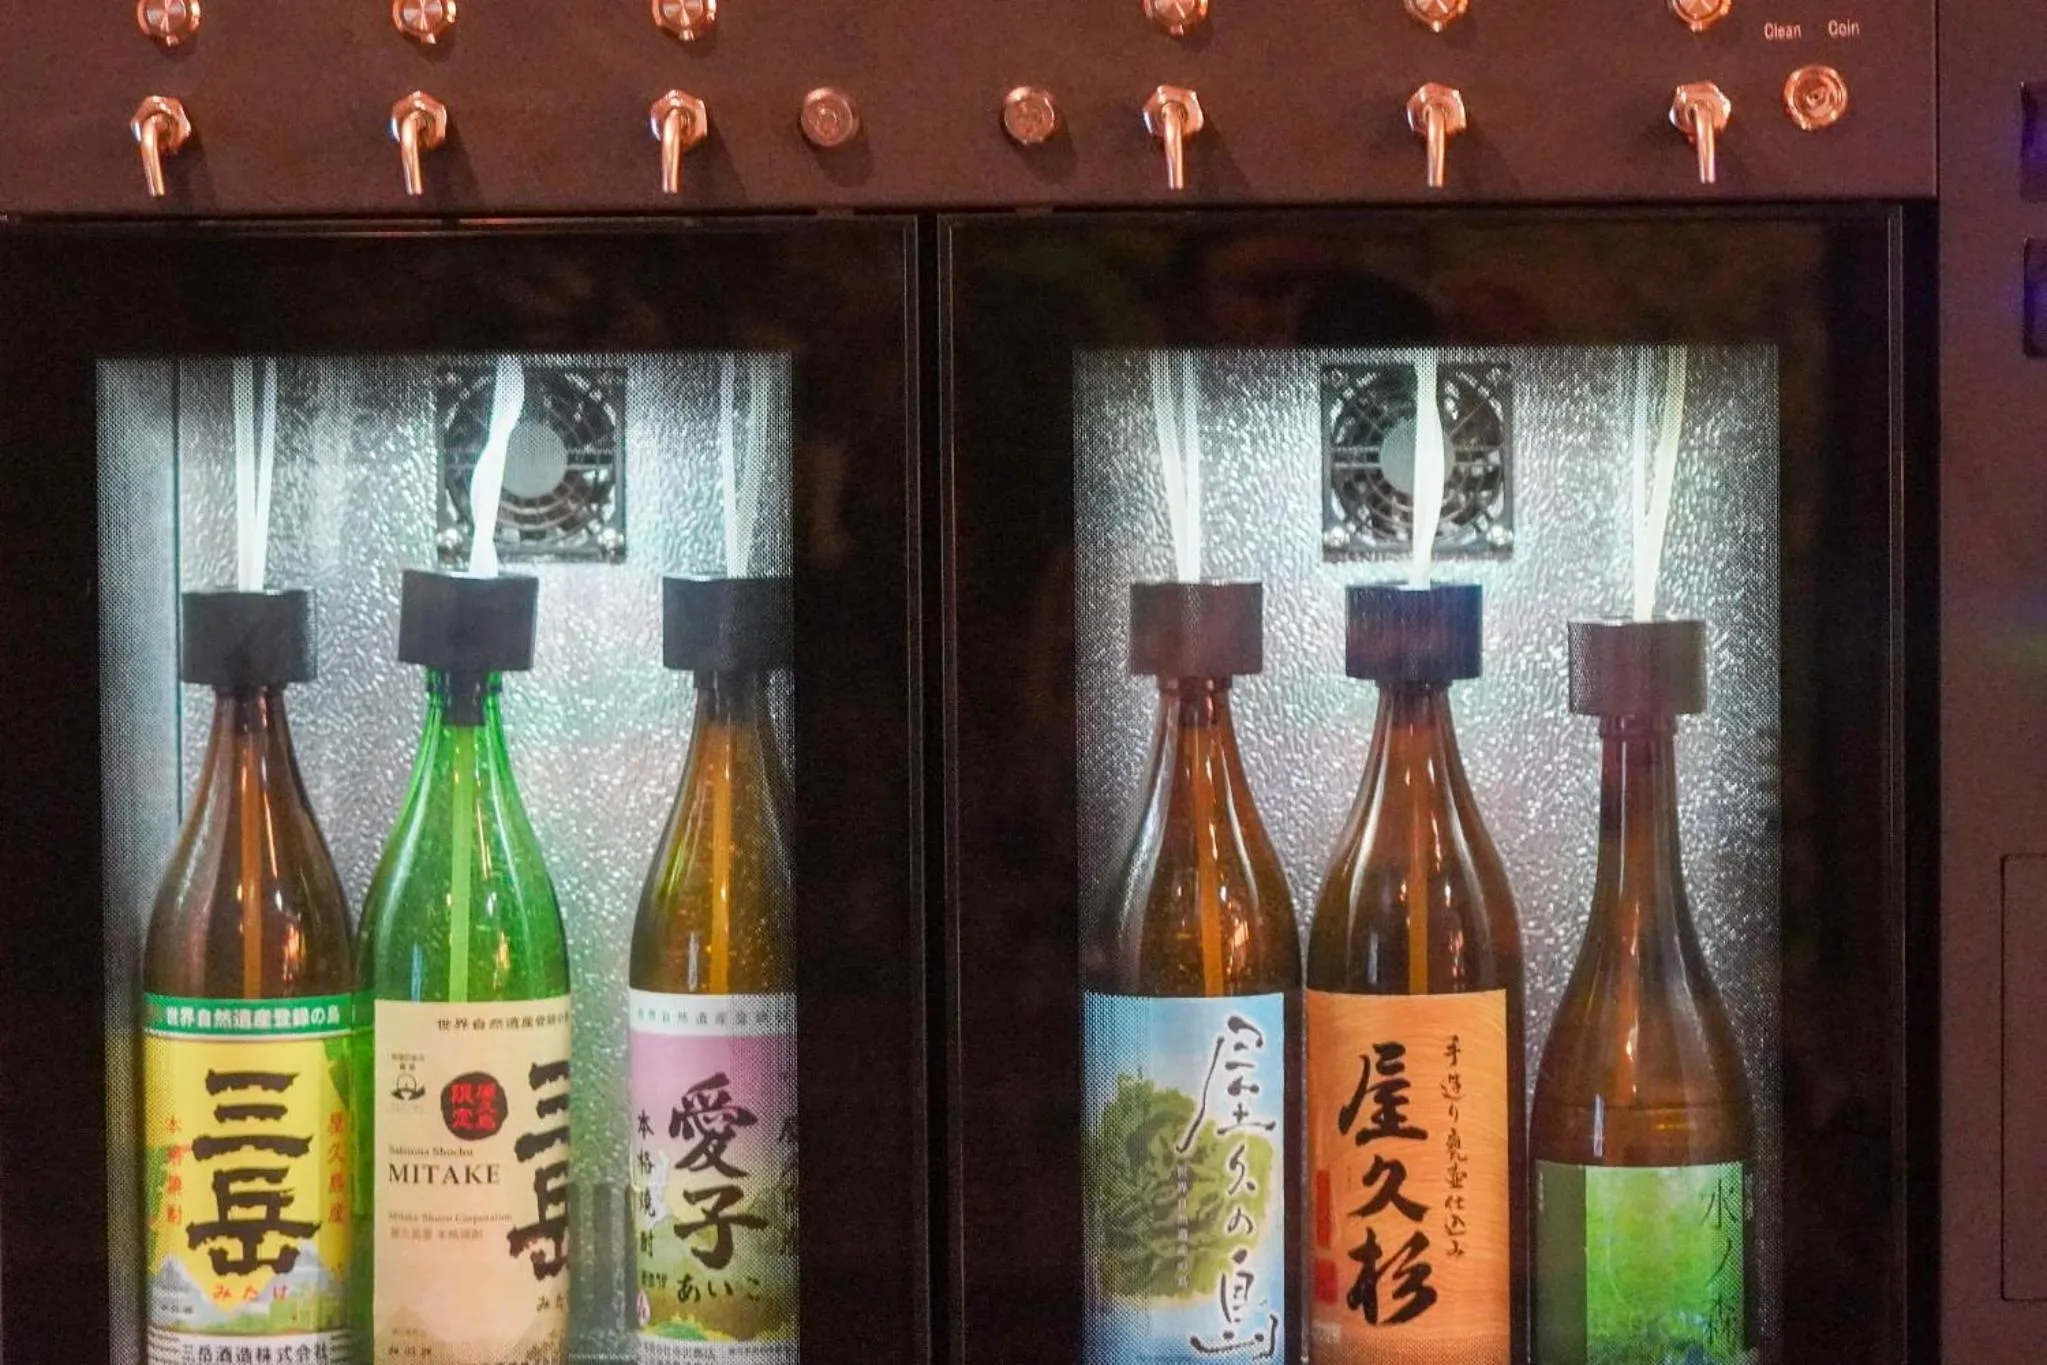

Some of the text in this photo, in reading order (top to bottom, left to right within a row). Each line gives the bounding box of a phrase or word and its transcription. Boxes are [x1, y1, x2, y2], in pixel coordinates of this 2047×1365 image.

[1764, 19, 1860, 40] Clean Coin
[166, 1006, 341, 1028] 世界自然遺産登録の島
[433, 1145, 474, 1157] Shochu
[186, 1069, 322, 1277] 三岳
[387, 1162, 500, 1185] MITAKE
[668, 1072, 769, 1271] 愛子
[1338, 1041, 1438, 1327] 屋久杉
[212, 1283, 289, 1303] みたけ
[676, 1272, 762, 1304] あいこ
